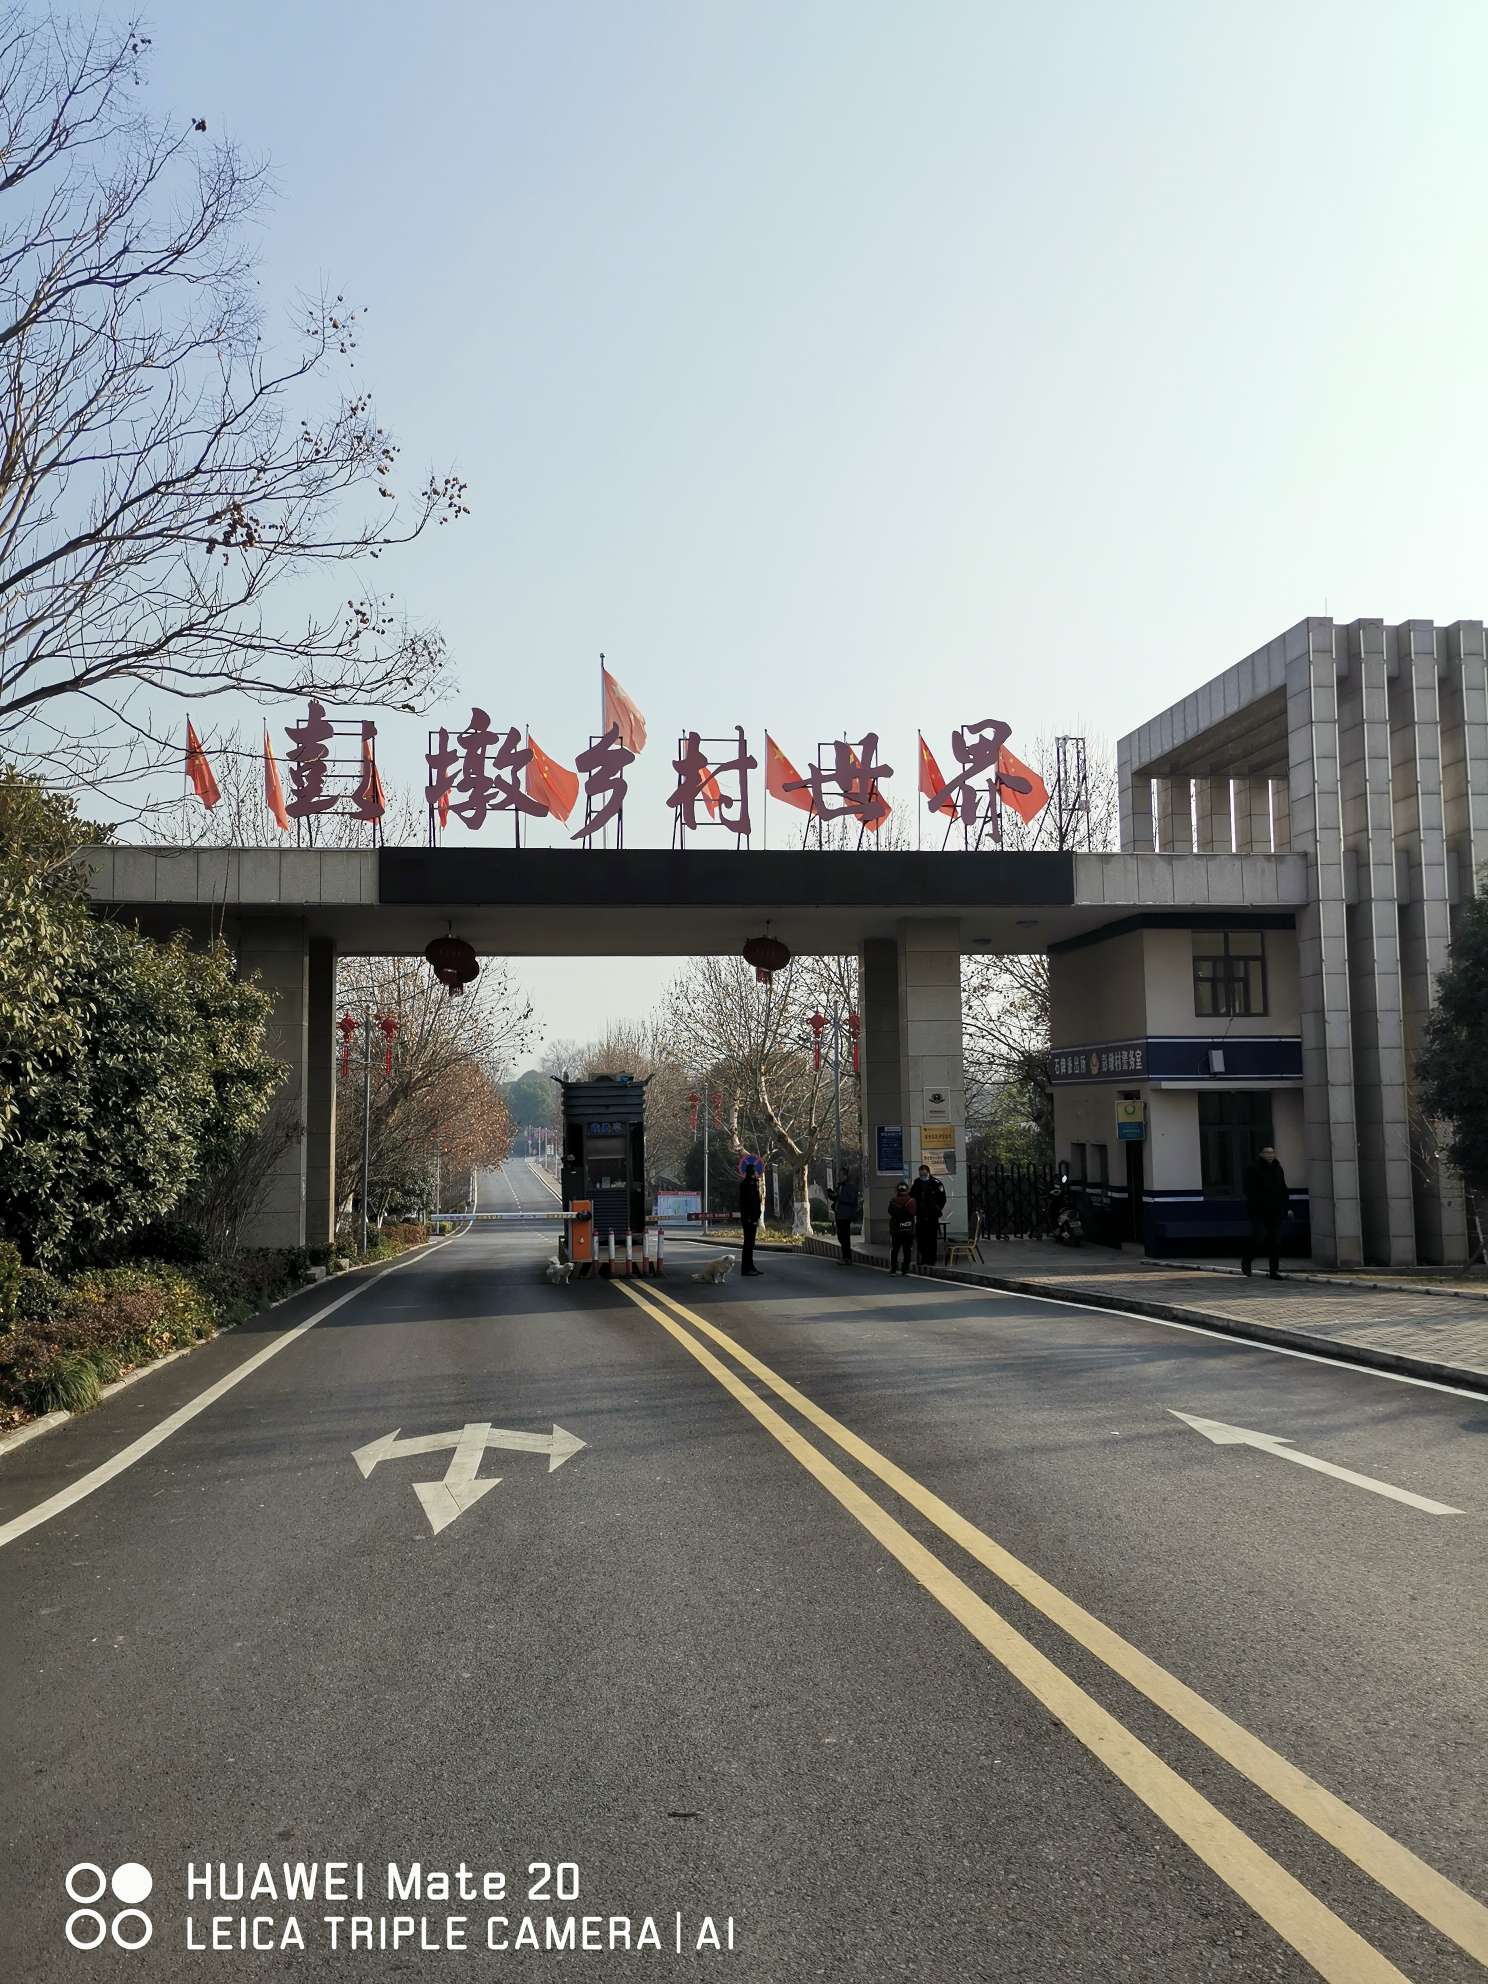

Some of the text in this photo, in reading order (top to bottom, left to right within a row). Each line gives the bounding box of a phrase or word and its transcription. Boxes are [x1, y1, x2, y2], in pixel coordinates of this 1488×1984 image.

[284, 699, 1033, 845] 彭墩乡村世界
